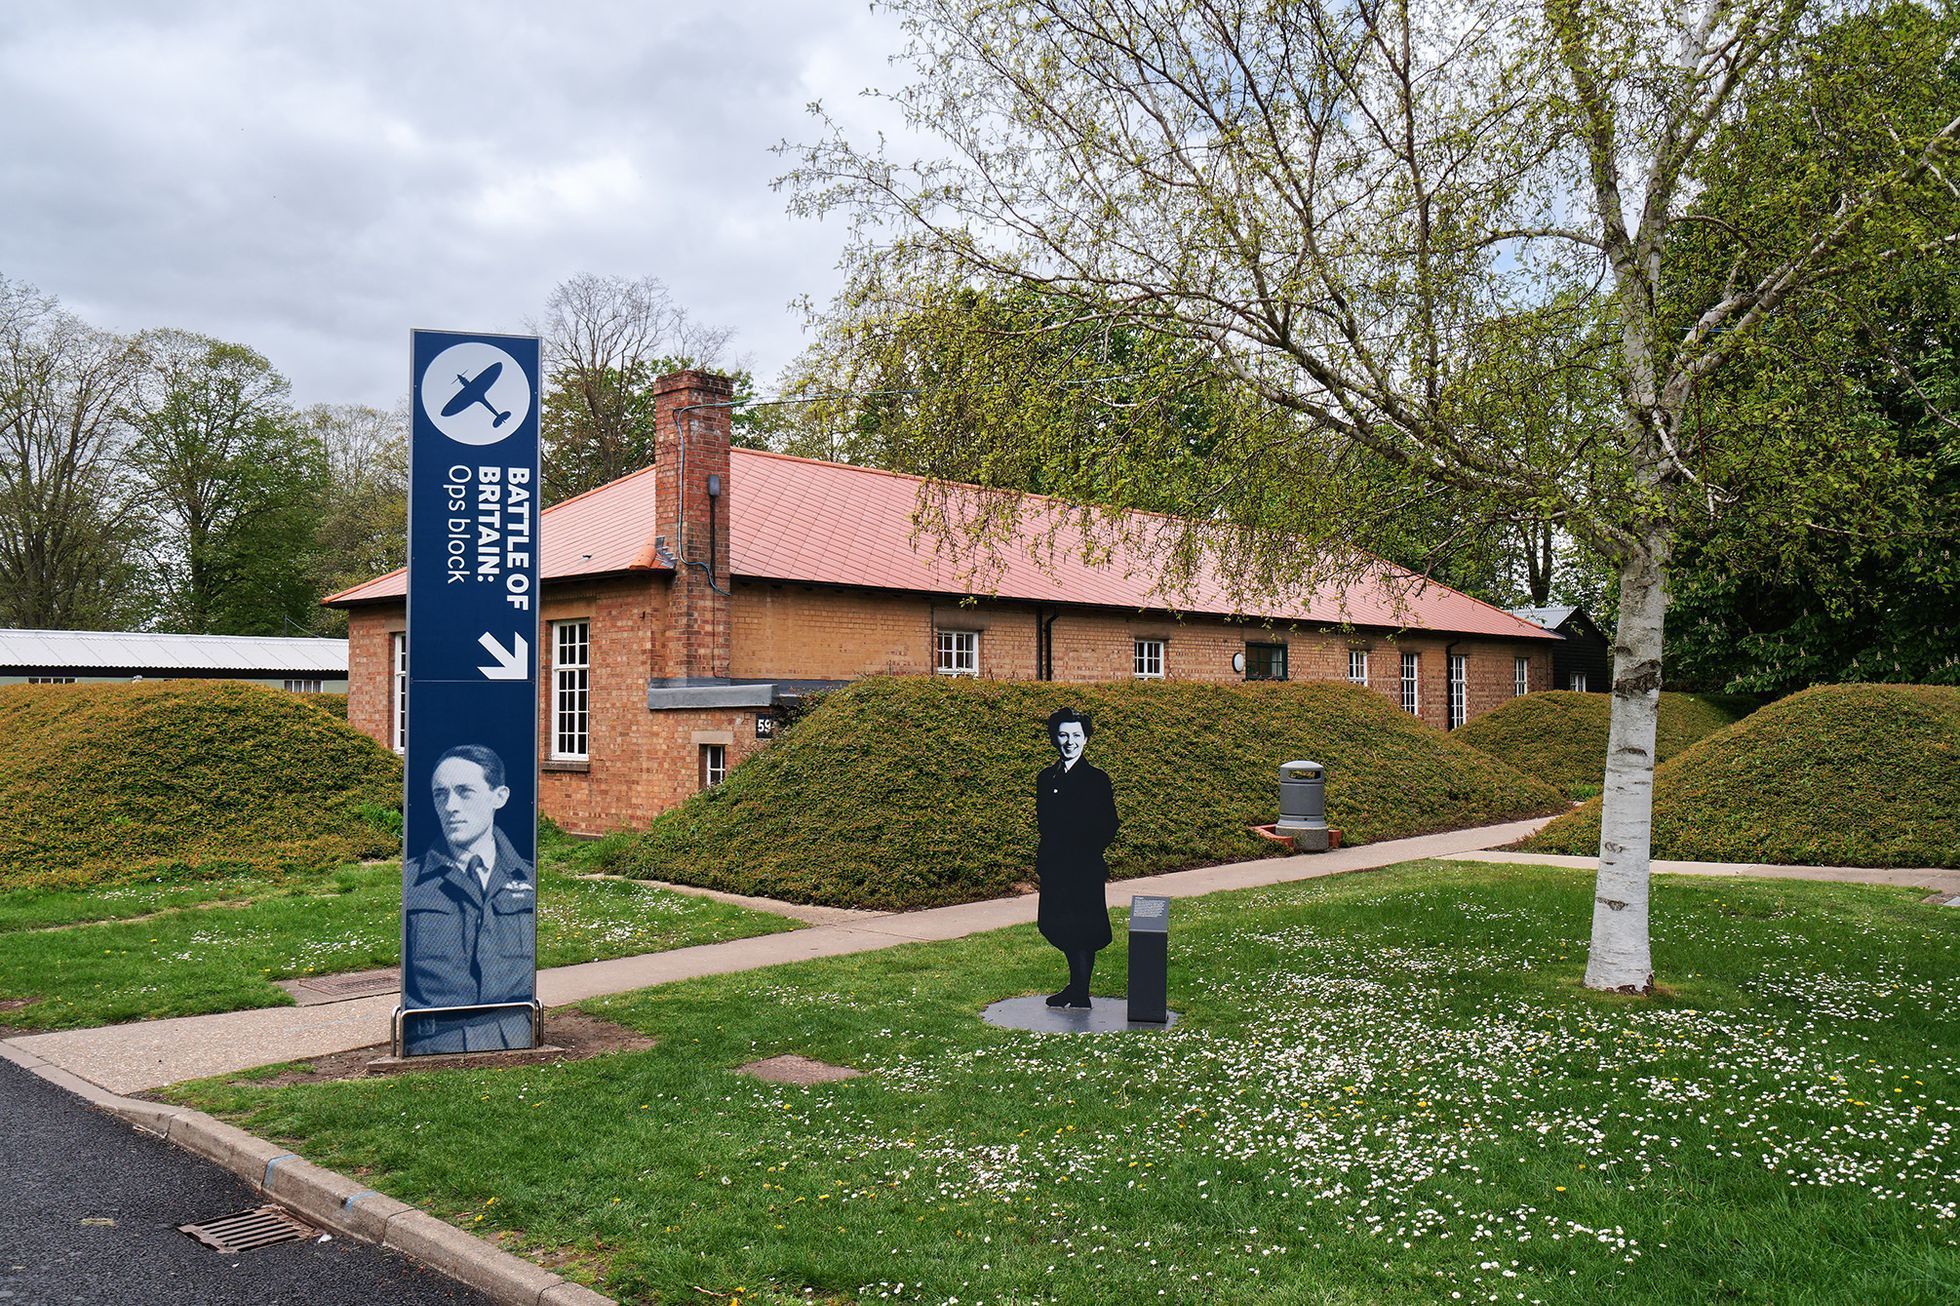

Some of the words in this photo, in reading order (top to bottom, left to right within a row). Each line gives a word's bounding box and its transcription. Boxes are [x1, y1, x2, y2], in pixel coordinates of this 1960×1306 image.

[442, 464, 472, 511] Ops
[477, 466, 501, 584] BRITAIN:
[506, 467, 530, 569] BATTLE
[447, 518, 472, 584] block
[506, 573, 529, 611] OF
[757, 718, 771, 733] 59
